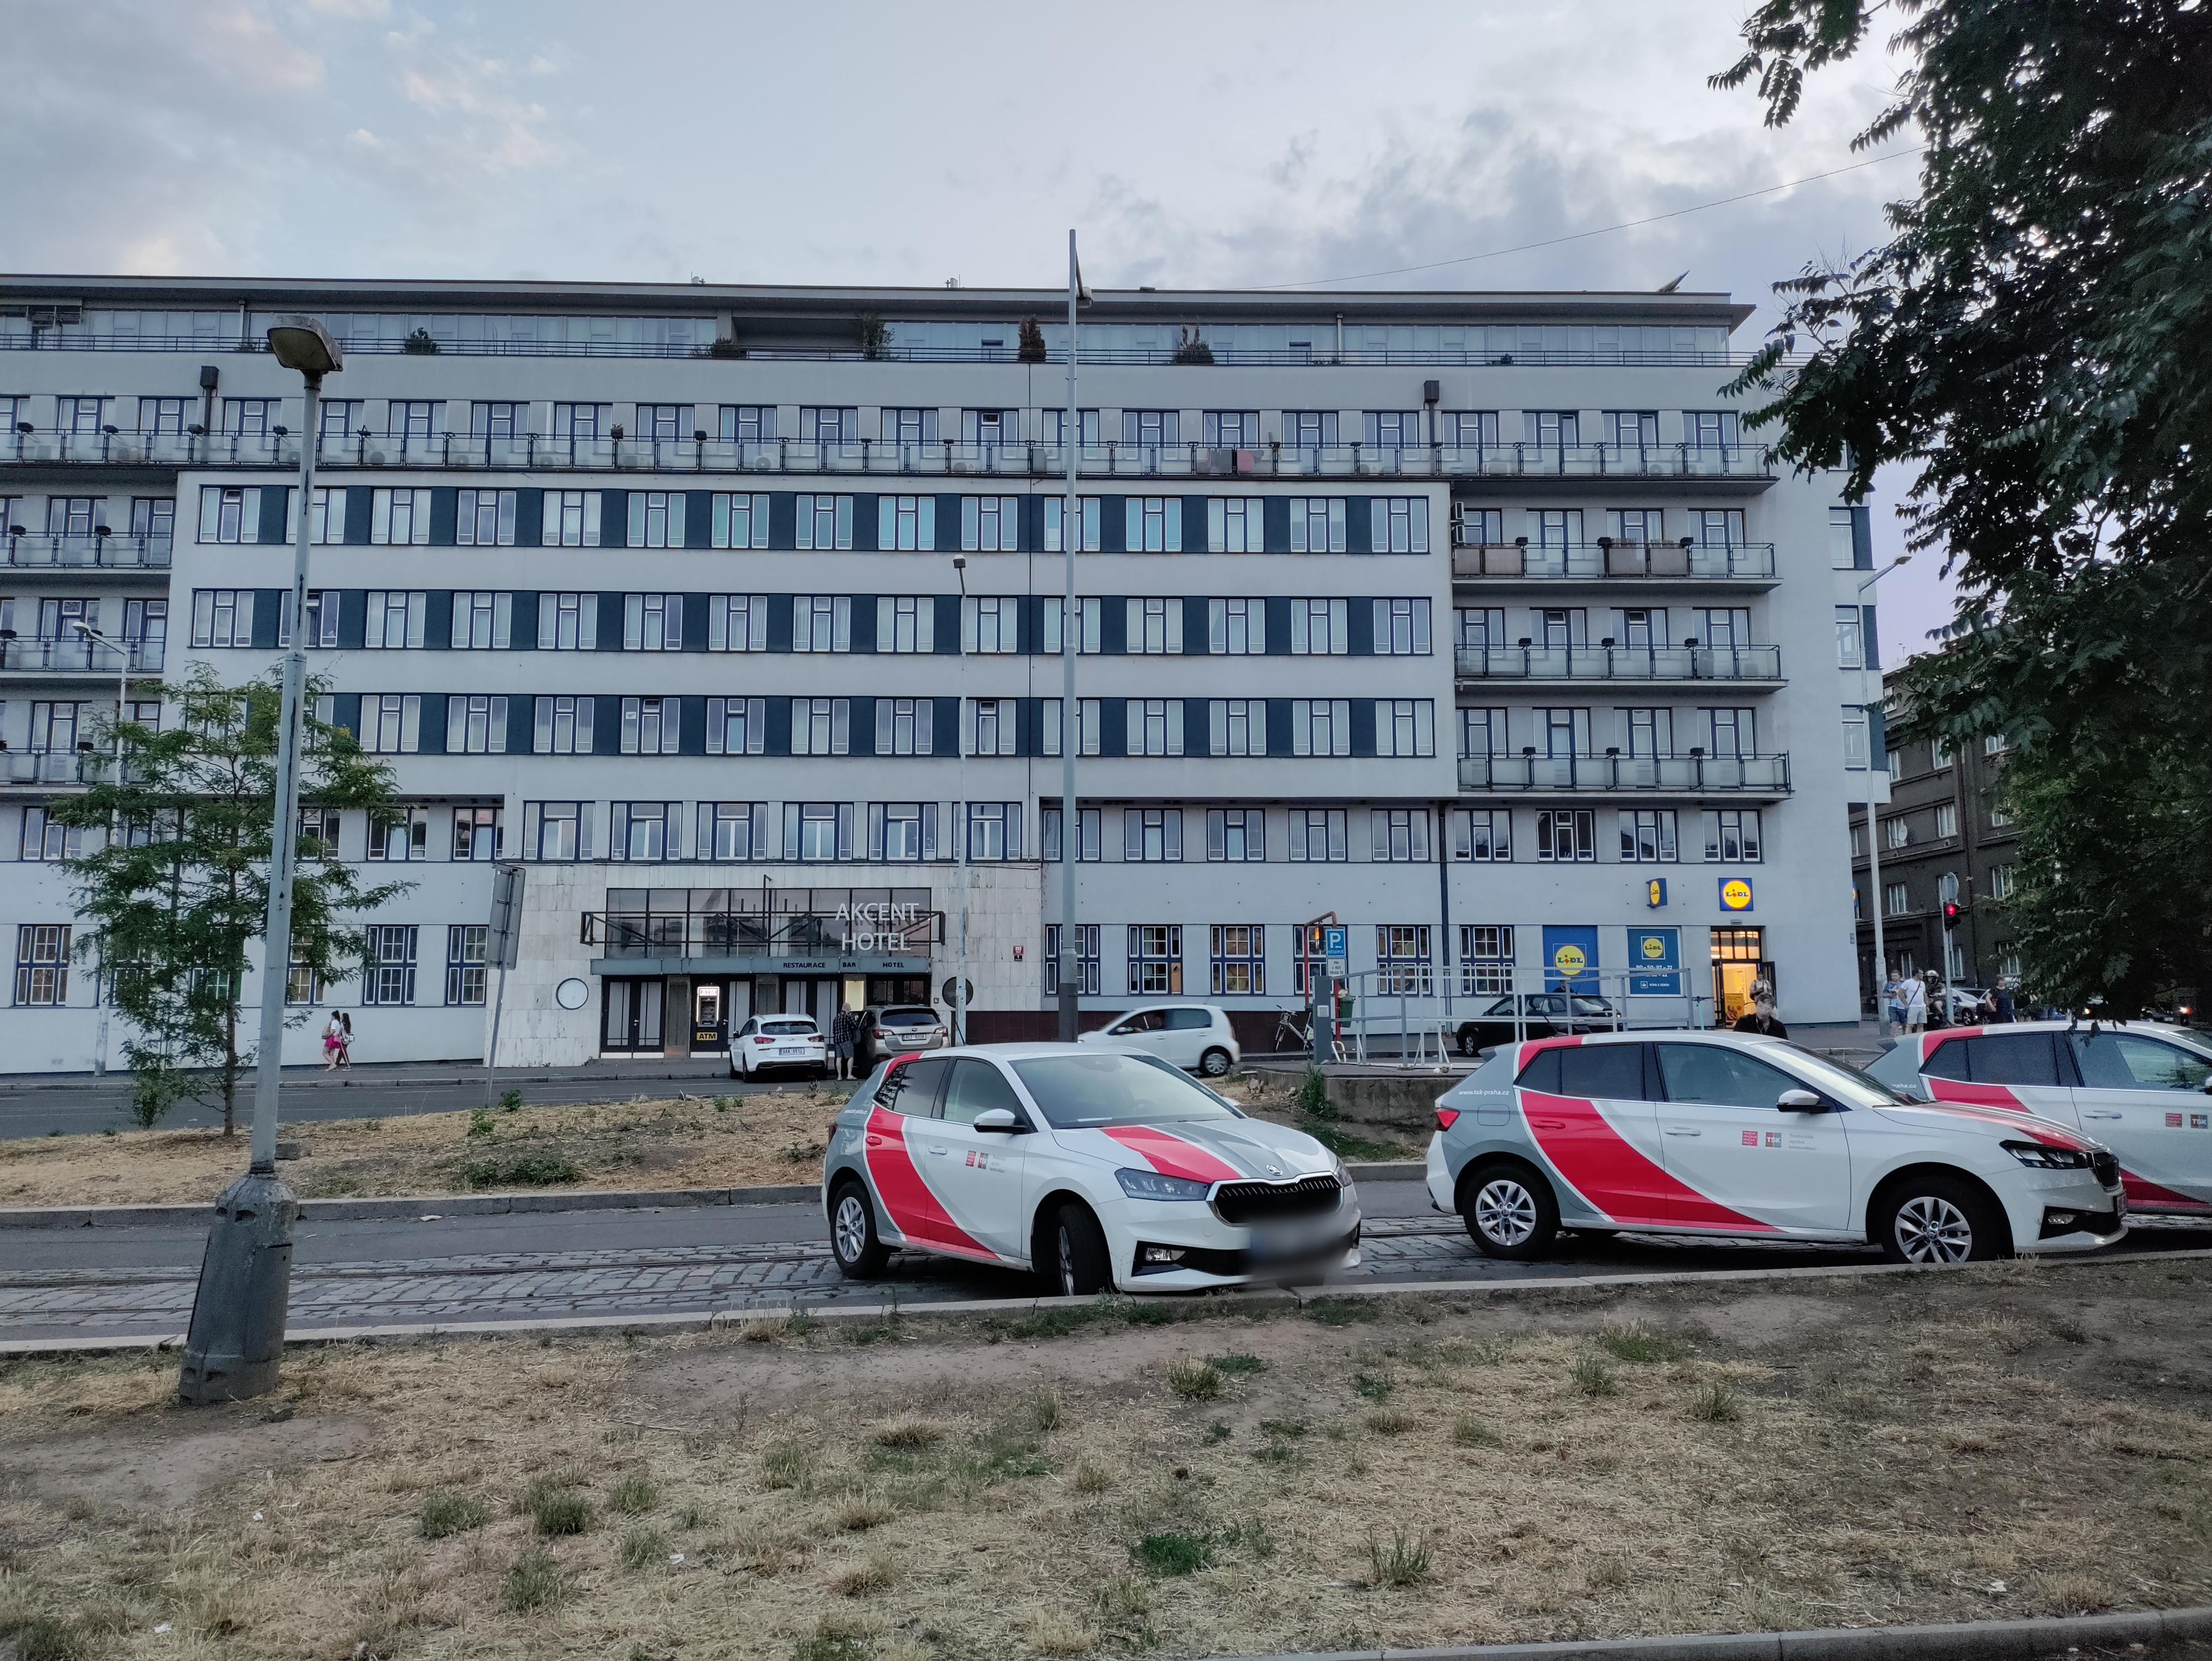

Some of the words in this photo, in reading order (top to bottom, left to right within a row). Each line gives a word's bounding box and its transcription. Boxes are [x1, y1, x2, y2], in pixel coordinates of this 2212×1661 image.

[835, 902, 920, 921] AKCENT
[842, 932, 911, 951] HOTEL
[1330, 932, 1341, 948] P
